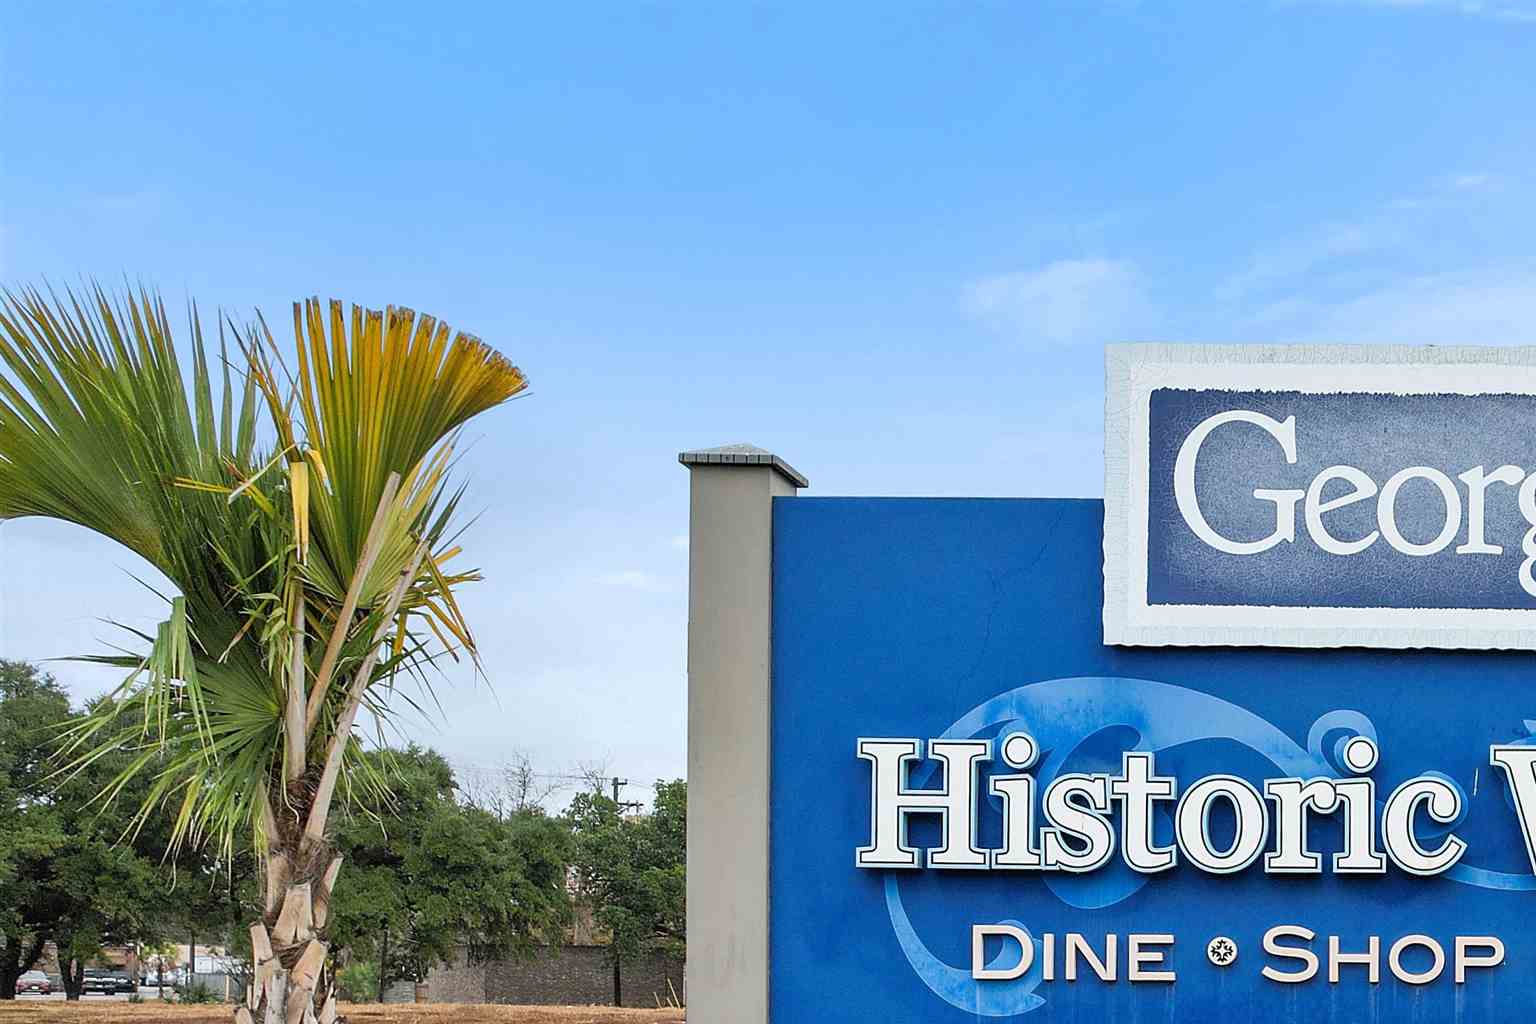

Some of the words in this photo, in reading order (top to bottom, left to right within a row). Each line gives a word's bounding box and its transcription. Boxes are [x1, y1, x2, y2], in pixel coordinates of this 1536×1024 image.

[856, 732, 1467, 876] Historic
[970, 922, 1176, 983] DINE
[1261, 924, 1506, 985] SHOP
